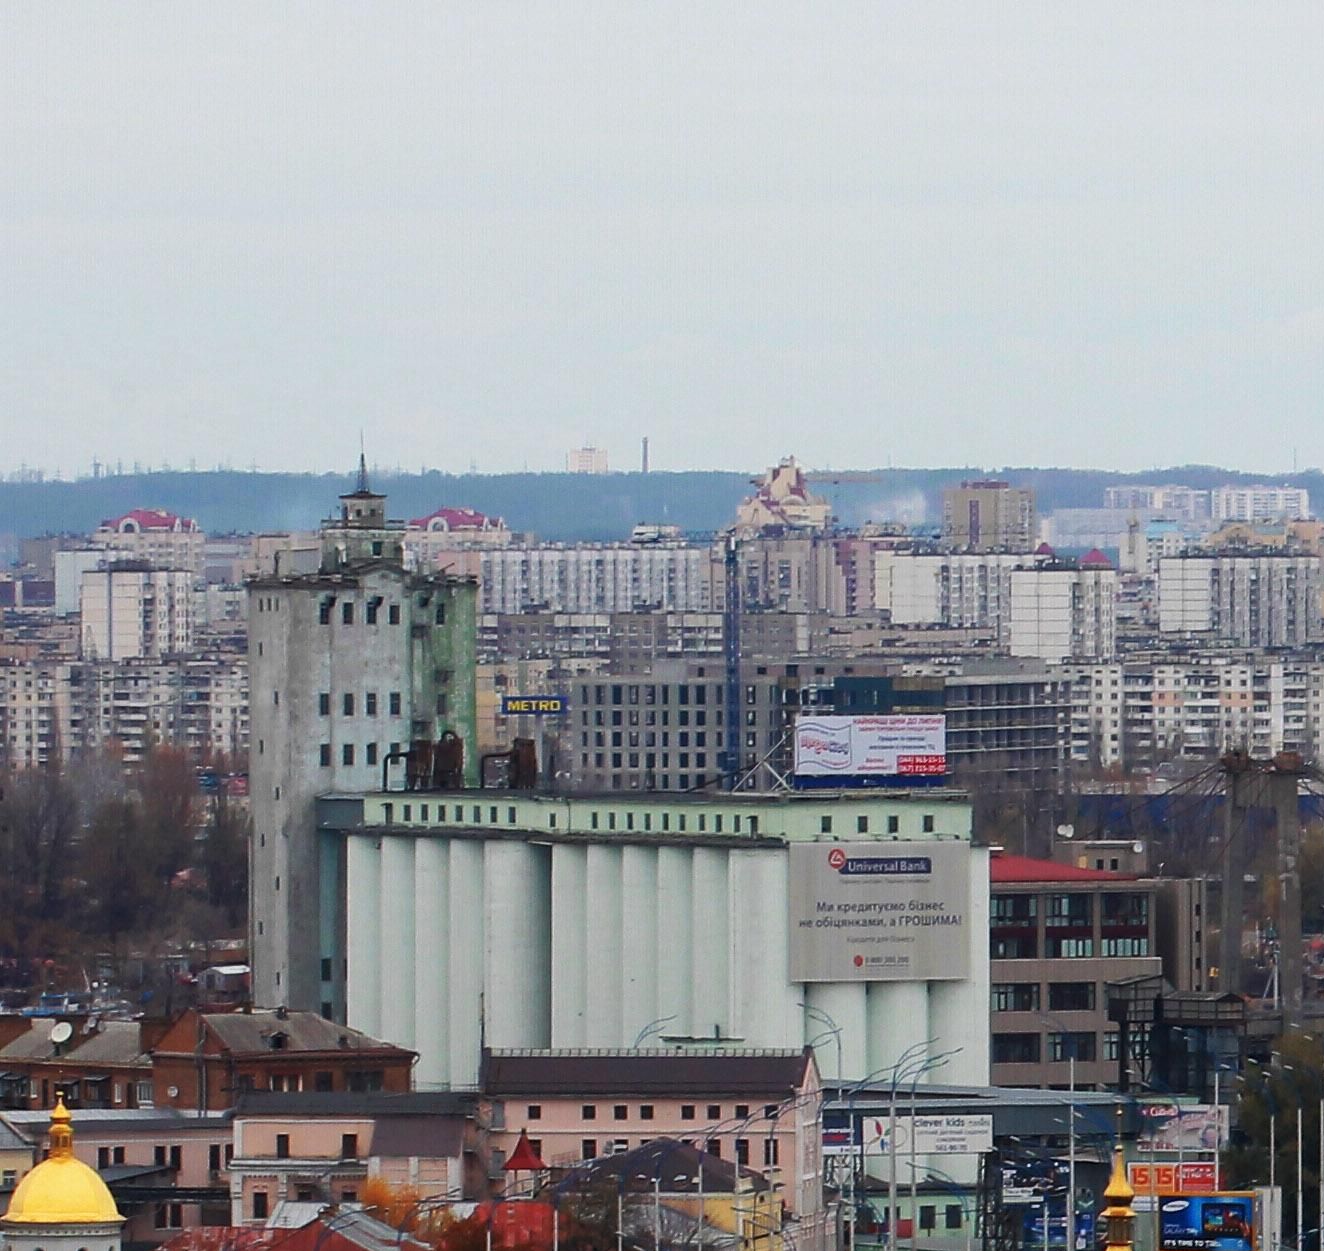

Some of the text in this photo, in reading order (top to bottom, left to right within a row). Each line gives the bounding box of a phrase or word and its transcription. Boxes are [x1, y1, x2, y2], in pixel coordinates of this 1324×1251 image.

[507, 700, 561, 711] METRO
[847, 861, 927, 872] Universal Bank
[816, 900, 945, 915] Ми кредитуємо бізнес
[799, 919, 813, 928] не
[889, 918, 896, 927] а
[898, 915, 962, 927] ГРОШИМА!
[914, 1118, 942, 1127] clever
[945, 1117, 965, 1127] kids
[1132, 1167, 1150, 1185] 15
[1155, 1167, 1174, 1185] 15
